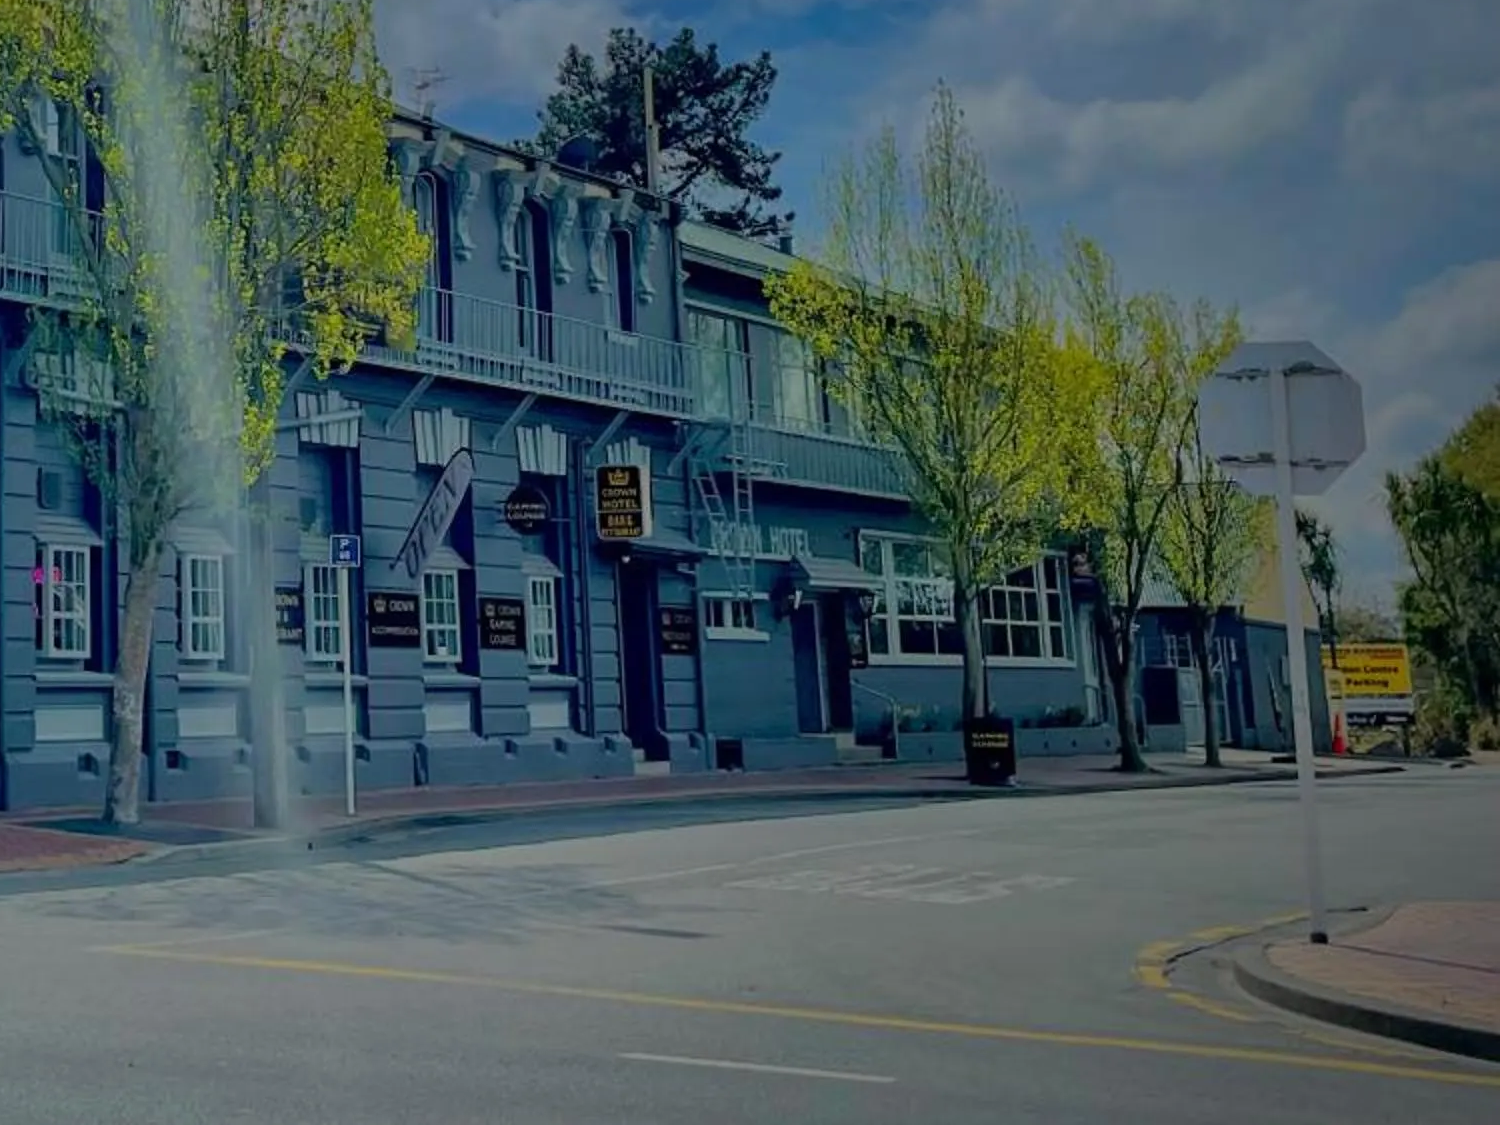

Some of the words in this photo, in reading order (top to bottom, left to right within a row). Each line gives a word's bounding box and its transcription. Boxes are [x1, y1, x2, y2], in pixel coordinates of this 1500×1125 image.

[602, 488, 637, 498] CROWN
[602, 498, 638, 508] HOTEL
[769, 525, 813, 557] HOTEL
[1345, 678, 1389, 688] Parking
